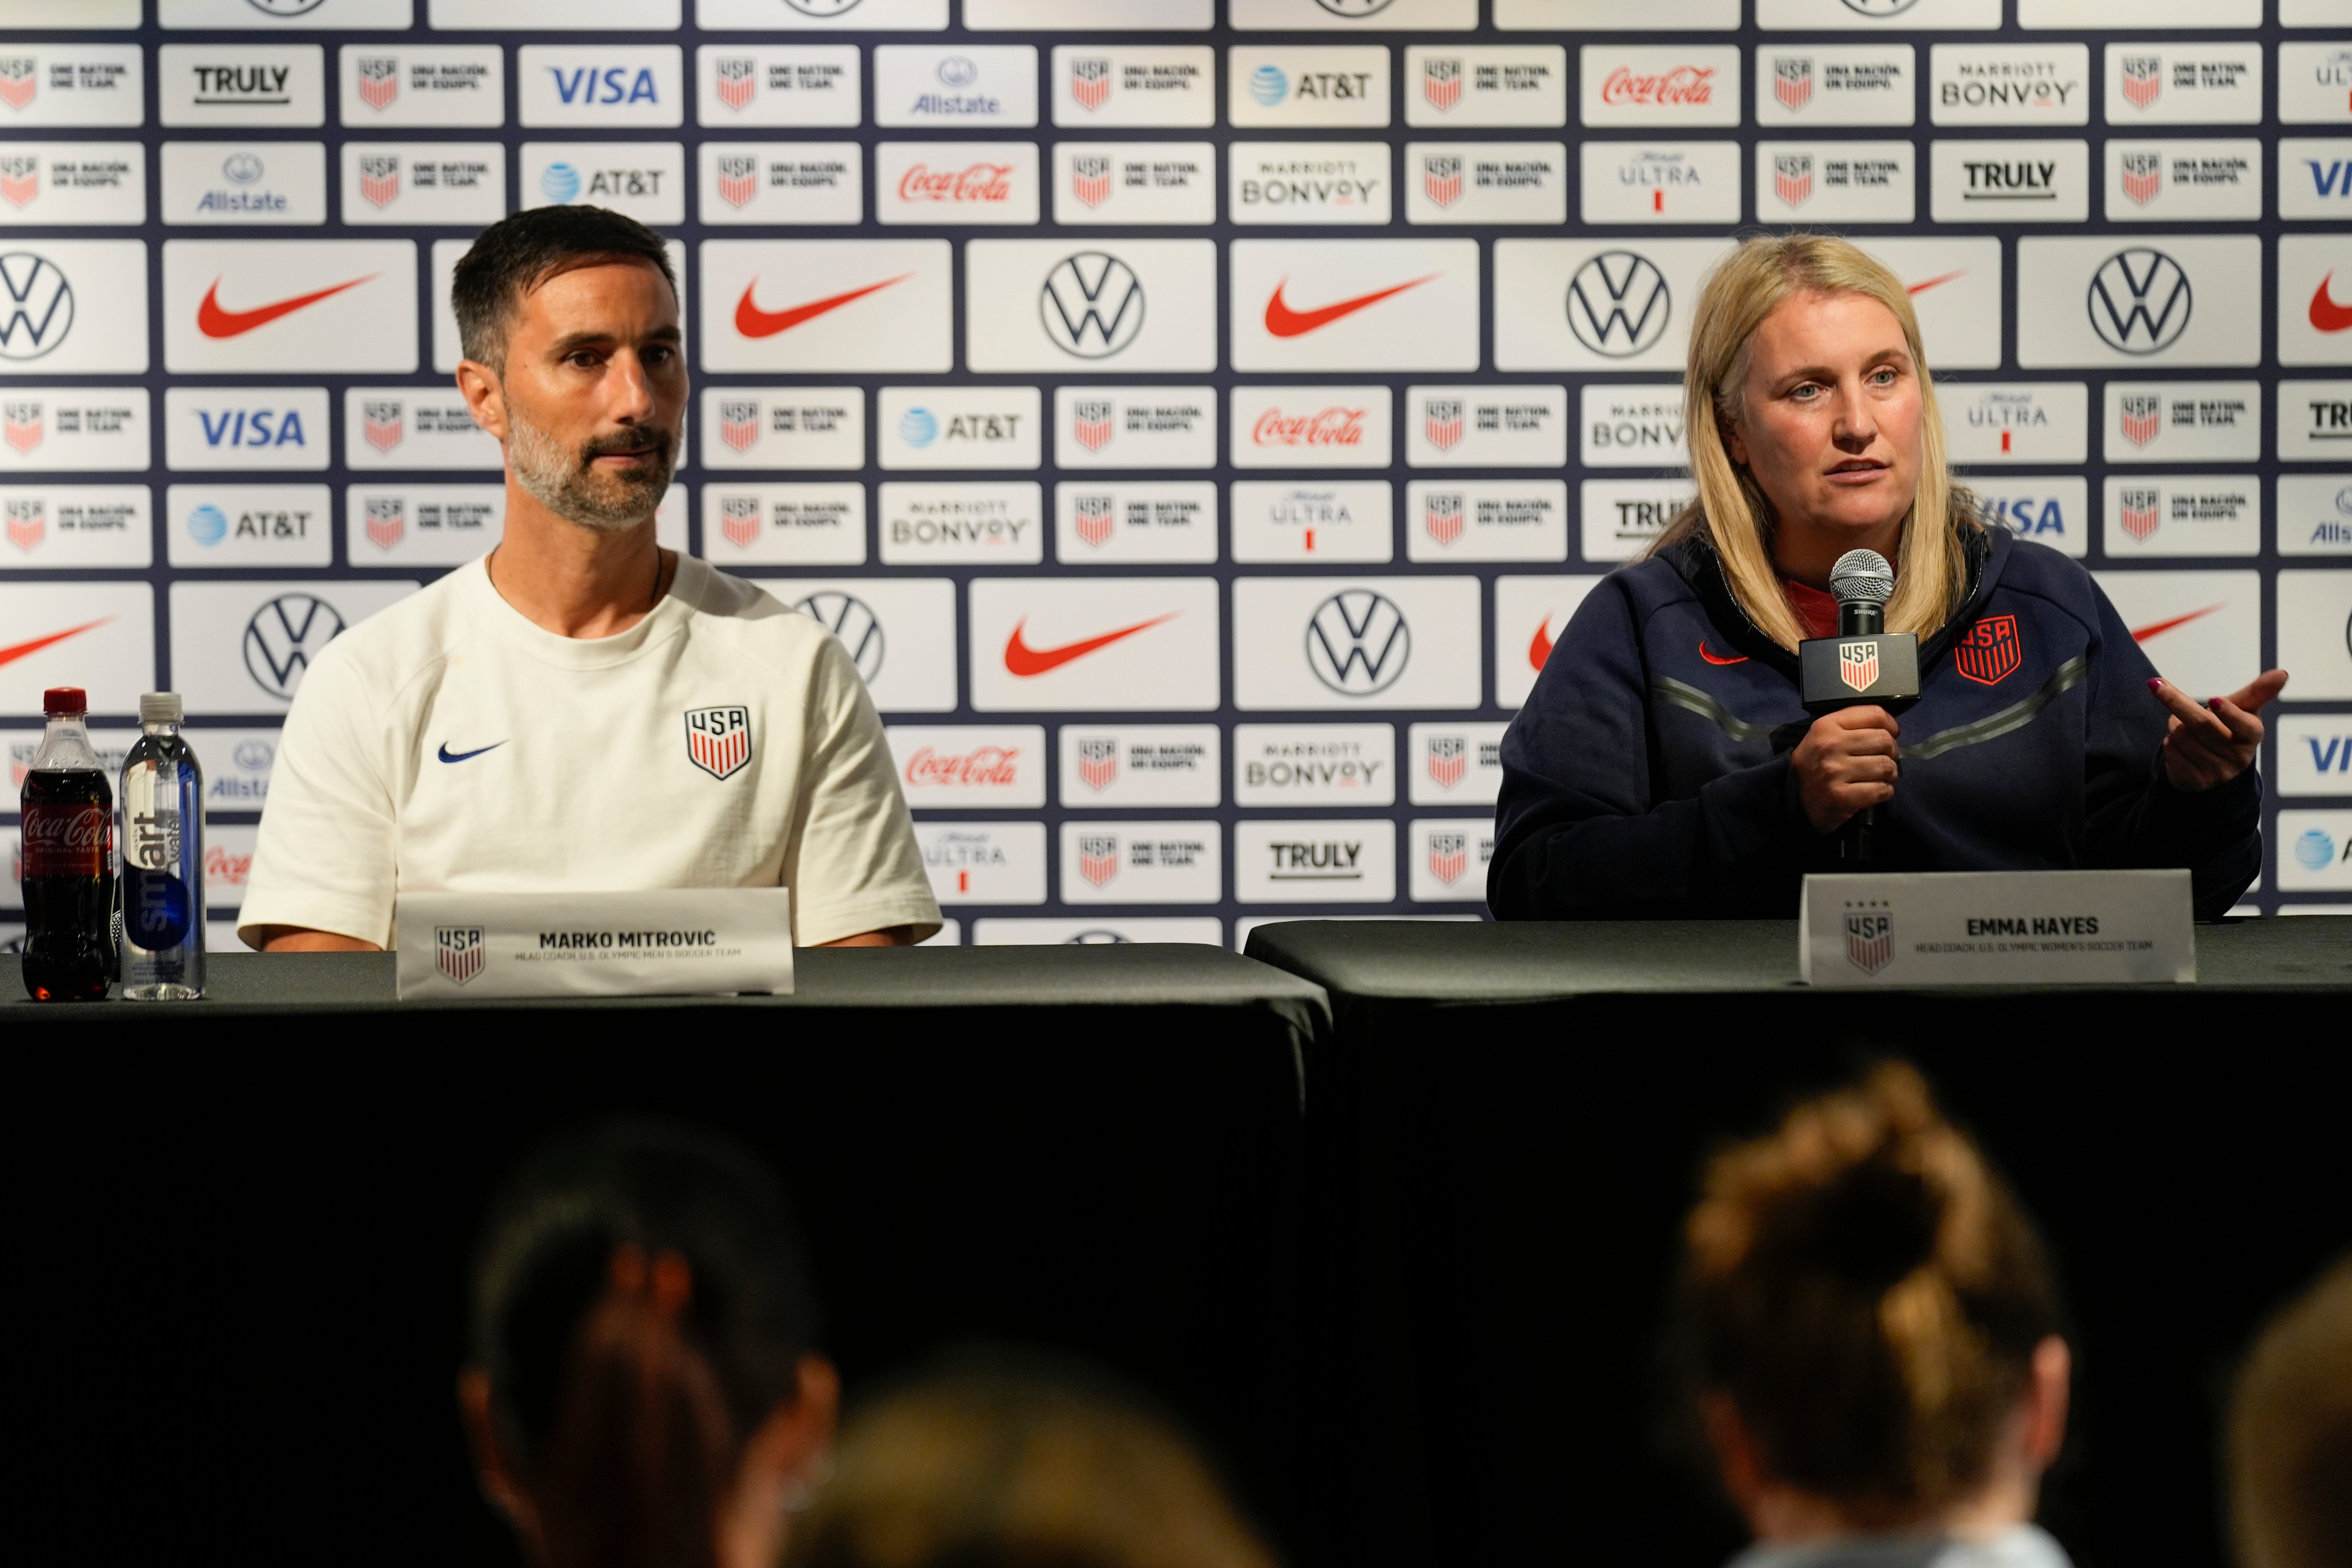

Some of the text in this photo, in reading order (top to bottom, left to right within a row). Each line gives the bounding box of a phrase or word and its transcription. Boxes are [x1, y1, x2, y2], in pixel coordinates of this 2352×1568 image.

[720, 61, 753, 81] USA
[1075, 61, 1107, 81] USA
[1428, 60, 1460, 80] USA
[1777, 60, 1810, 81] USA
[1959, 63, 2055, 76] MARRIOTT
[2125, 58, 2158, 79] USA
[193, 66, 289, 93] TRULY
[547, 68, 657, 104] VISA
[1298, 74, 1371, 99] AT&T
[1942, 82, 2071, 106] BONVOY
[911, 94, 999, 115] Allstate
[722, 158, 754, 178] USA
[1076, 157, 1109, 178] USA
[1260, 161, 1356, 174] MARRIOTT
[1428, 157, 1460, 177] USA
[1777, 156, 1810, 176] USA
[1964, 162, 2055, 188] TRULY
[2125, 155, 2158, 175] USA
[589, 171, 663, 196] AT&T
[1619, 166, 1701, 185] ULTRA
[2304, 160, 2352, 197] VI
[198, 191, 286, 212] Allstate
[1242, 180, 1375, 204] BONVOY
[724, 404, 757, 424] USA
[1078, 402, 1111, 423] USA
[1429, 400, 1461, 421] USA
[1968, 407, 2047, 426] ULTRA
[2124, 397, 2157, 417] USA
[195, 410, 305, 447] VISA
[947, 415, 1020, 440] AT&T
[1593, 423, 1683, 447] BONV
[724, 498, 758, 518] USA
[909, 501, 1007, 514] MARRIOTT
[1079, 497, 1111, 517] USA
[1429, 495, 1462, 515] USA
[2124, 491, 2157, 511] USA
[1271, 504, 1352, 524] ULTRA
[1616, 502, 1680, 528] TRU
[1985, 499, 2064, 537] ISA
[236, 513, 311, 539] AT&T
[892, 520, 1026, 544] BONVOY
[2311, 523, 2352, 543] Alls
[1842, 645, 1875, 663] USA
[692, 711, 743, 735] USA
[13, 745, 34, 764] US
[1082, 741, 1114, 761] USA
[1264, 743, 1360, 756] MARRIOTT
[1431, 737, 1464, 757] USA
[2305, 737, 2352, 772] VI
[1246, 762, 1378, 786] BONVOY
[209, 778, 269, 798] Allst
[23, 807, 111, 846] Coca-Cola
[1083, 836, 1115, 856] USA
[1432, 834, 1464, 854] USA
[926, 847, 1006, 865] ULTRA
[1270, 843, 1361, 869] TRULY
[134, 812, 168, 932] smart
[1848, 917, 1888, 939] USA
[1967, 916, 2099, 936] EMMA HAYES
[439, 930, 480, 951] USA
[539, 932, 612, 948] MARKO
[515, 952, 541, 960] HEAD
[715, 948, 742, 957] TEAM
